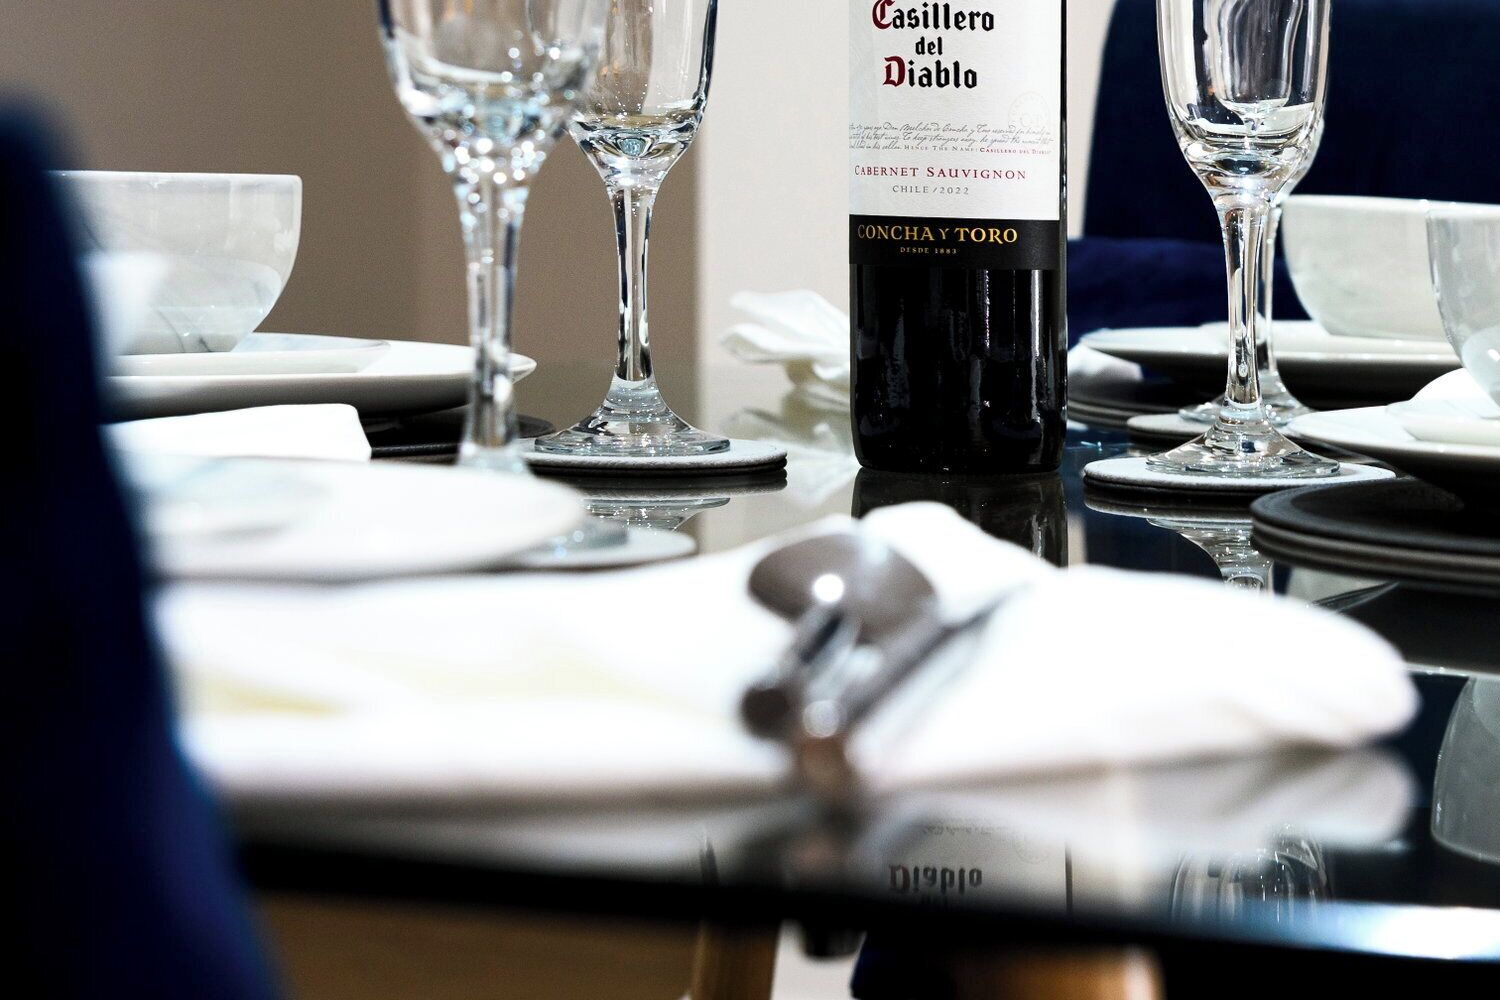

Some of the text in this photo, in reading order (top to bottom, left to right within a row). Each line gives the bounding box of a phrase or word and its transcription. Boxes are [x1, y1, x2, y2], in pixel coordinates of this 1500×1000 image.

[915, 36, 943, 55] del
[883, 56, 977, 89] Diablo
[854, 165, 1026, 180] CABERNET SAUVIGNON
[892, 185, 929, 194] CHILE
[939, 186, 970, 195] 2022
[857, 225, 1018, 244] CONCHA Y TORO
[900, 246, 930, 254] DESDE
